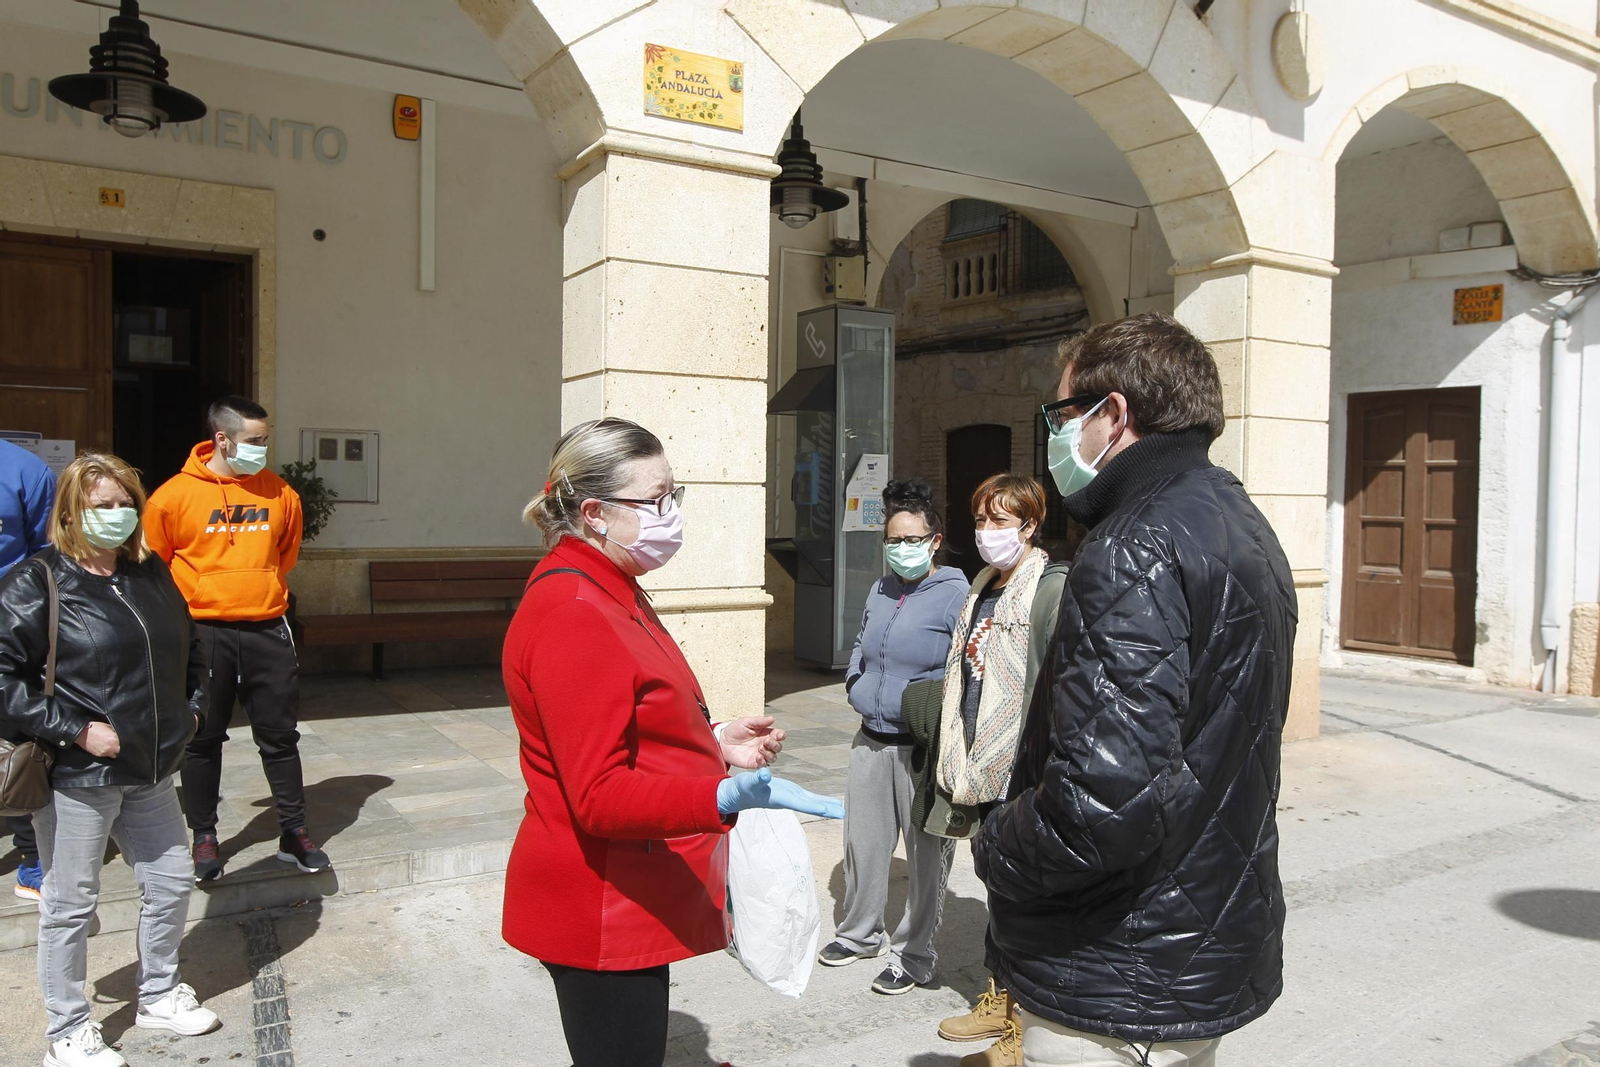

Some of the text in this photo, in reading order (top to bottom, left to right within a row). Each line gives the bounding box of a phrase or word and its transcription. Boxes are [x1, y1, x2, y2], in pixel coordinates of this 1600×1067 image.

[675, 70, 709, 84] PLAZA
[660, 81, 723, 99] ANDALUCIA
[1463, 290, 1488, 299] CALLE
[1462, 300, 1493, 309] SANTO
[1461, 310, 1493, 320] CRISTO
[208, 504, 269, 524] KTM
[205, 524, 270, 533] RACING
